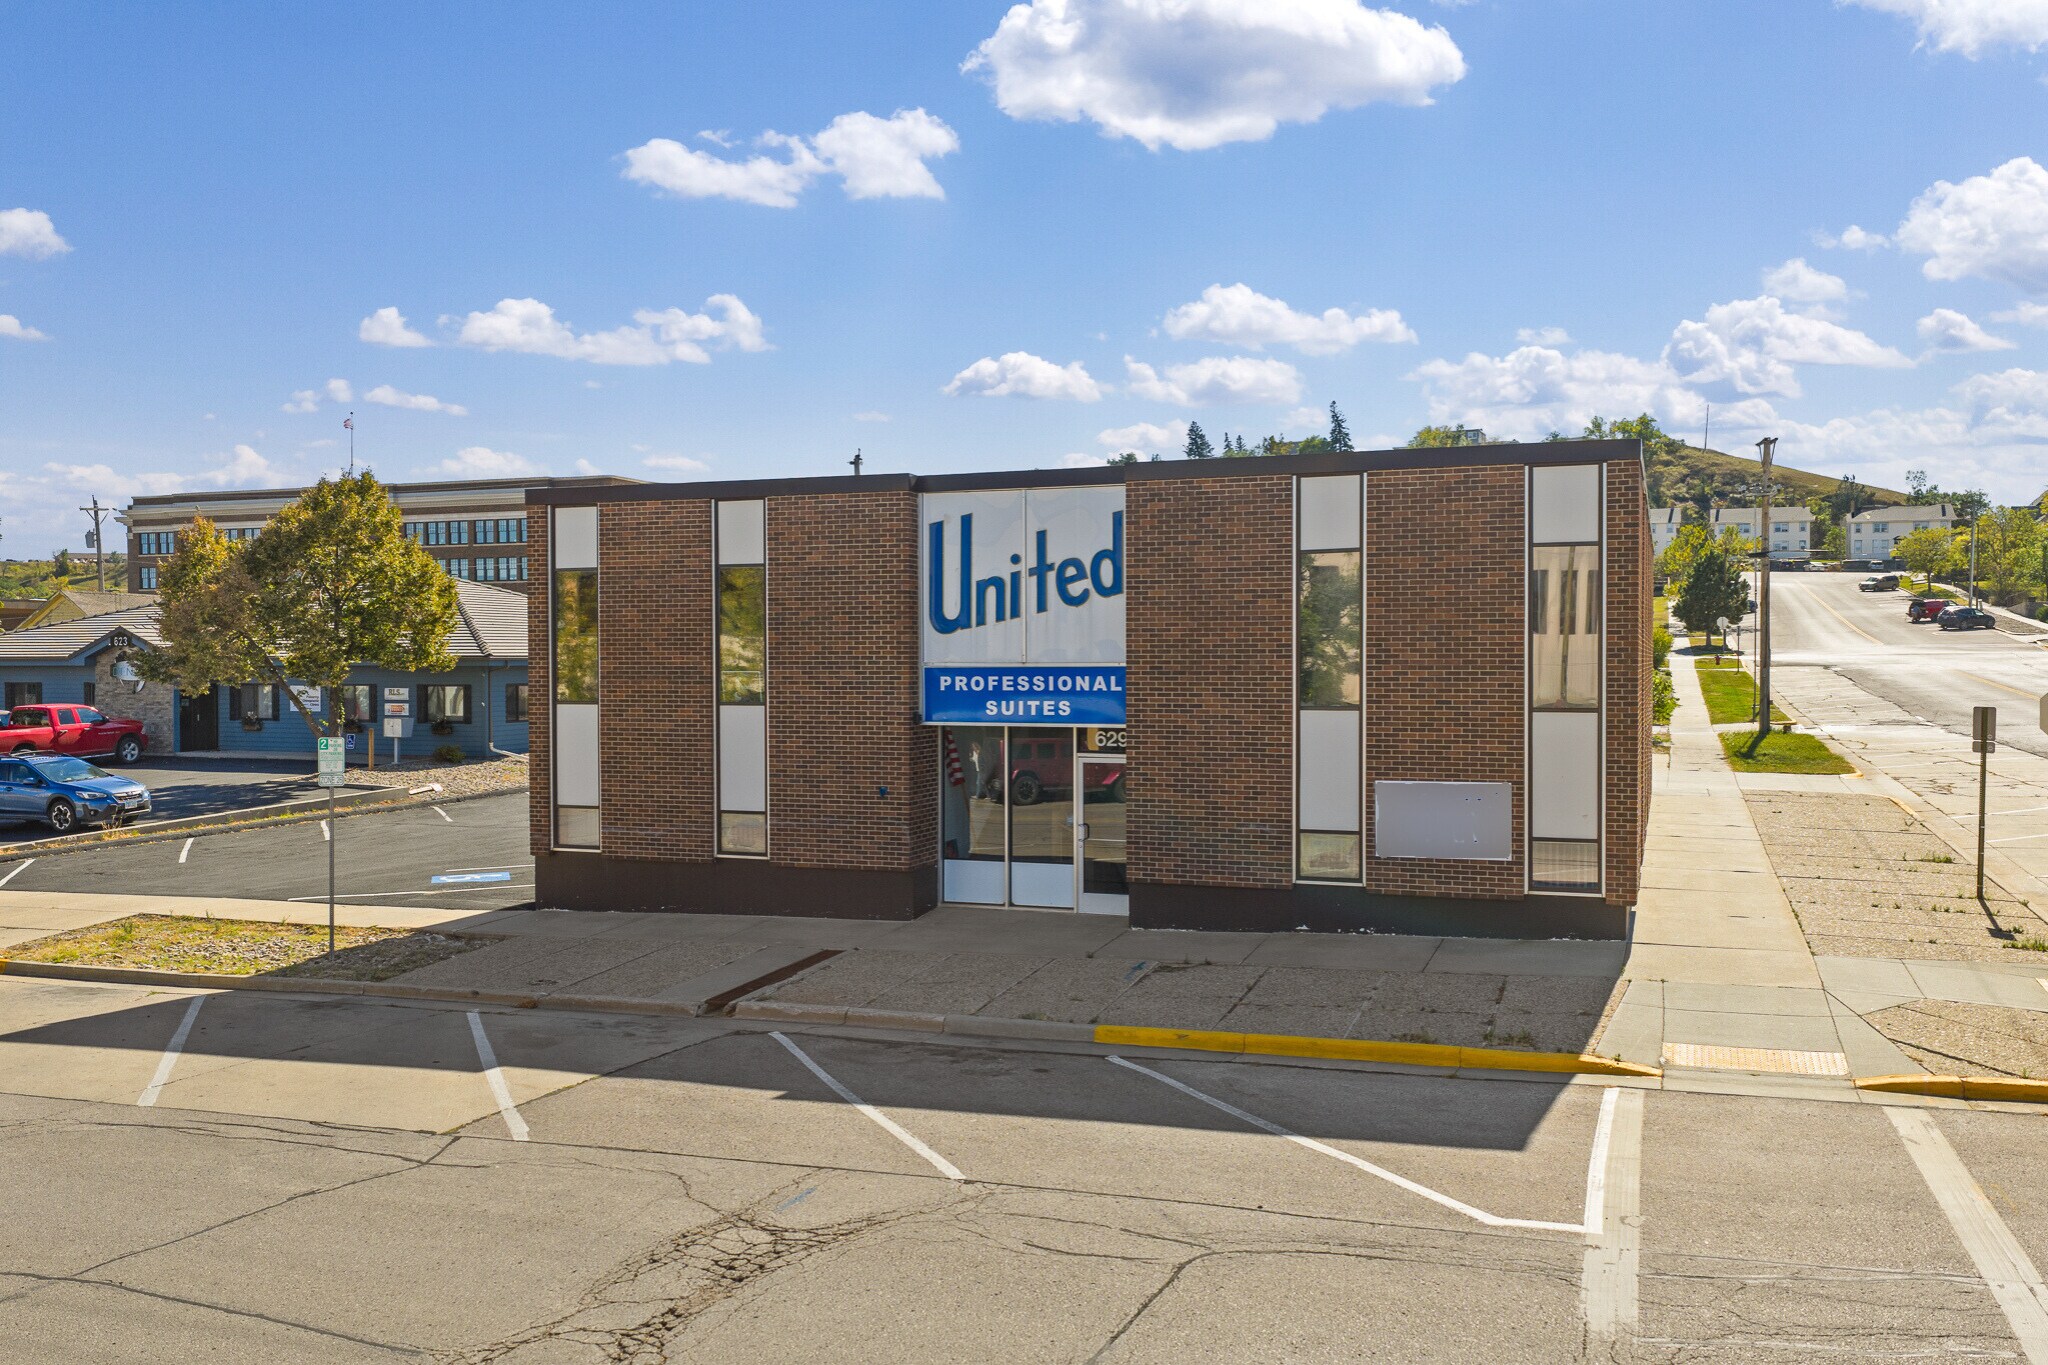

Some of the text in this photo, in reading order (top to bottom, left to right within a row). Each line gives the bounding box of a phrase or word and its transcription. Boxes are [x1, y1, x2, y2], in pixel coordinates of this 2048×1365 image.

[929, 510, 1124, 635] United
[113, 636, 128, 646] 623
[940, 676, 1122, 692] PROFESSIONAL
[985, 701, 1071, 716] SUITES
[320, 739, 327, 749] 2
[1095, 731, 1127, 747] 629
